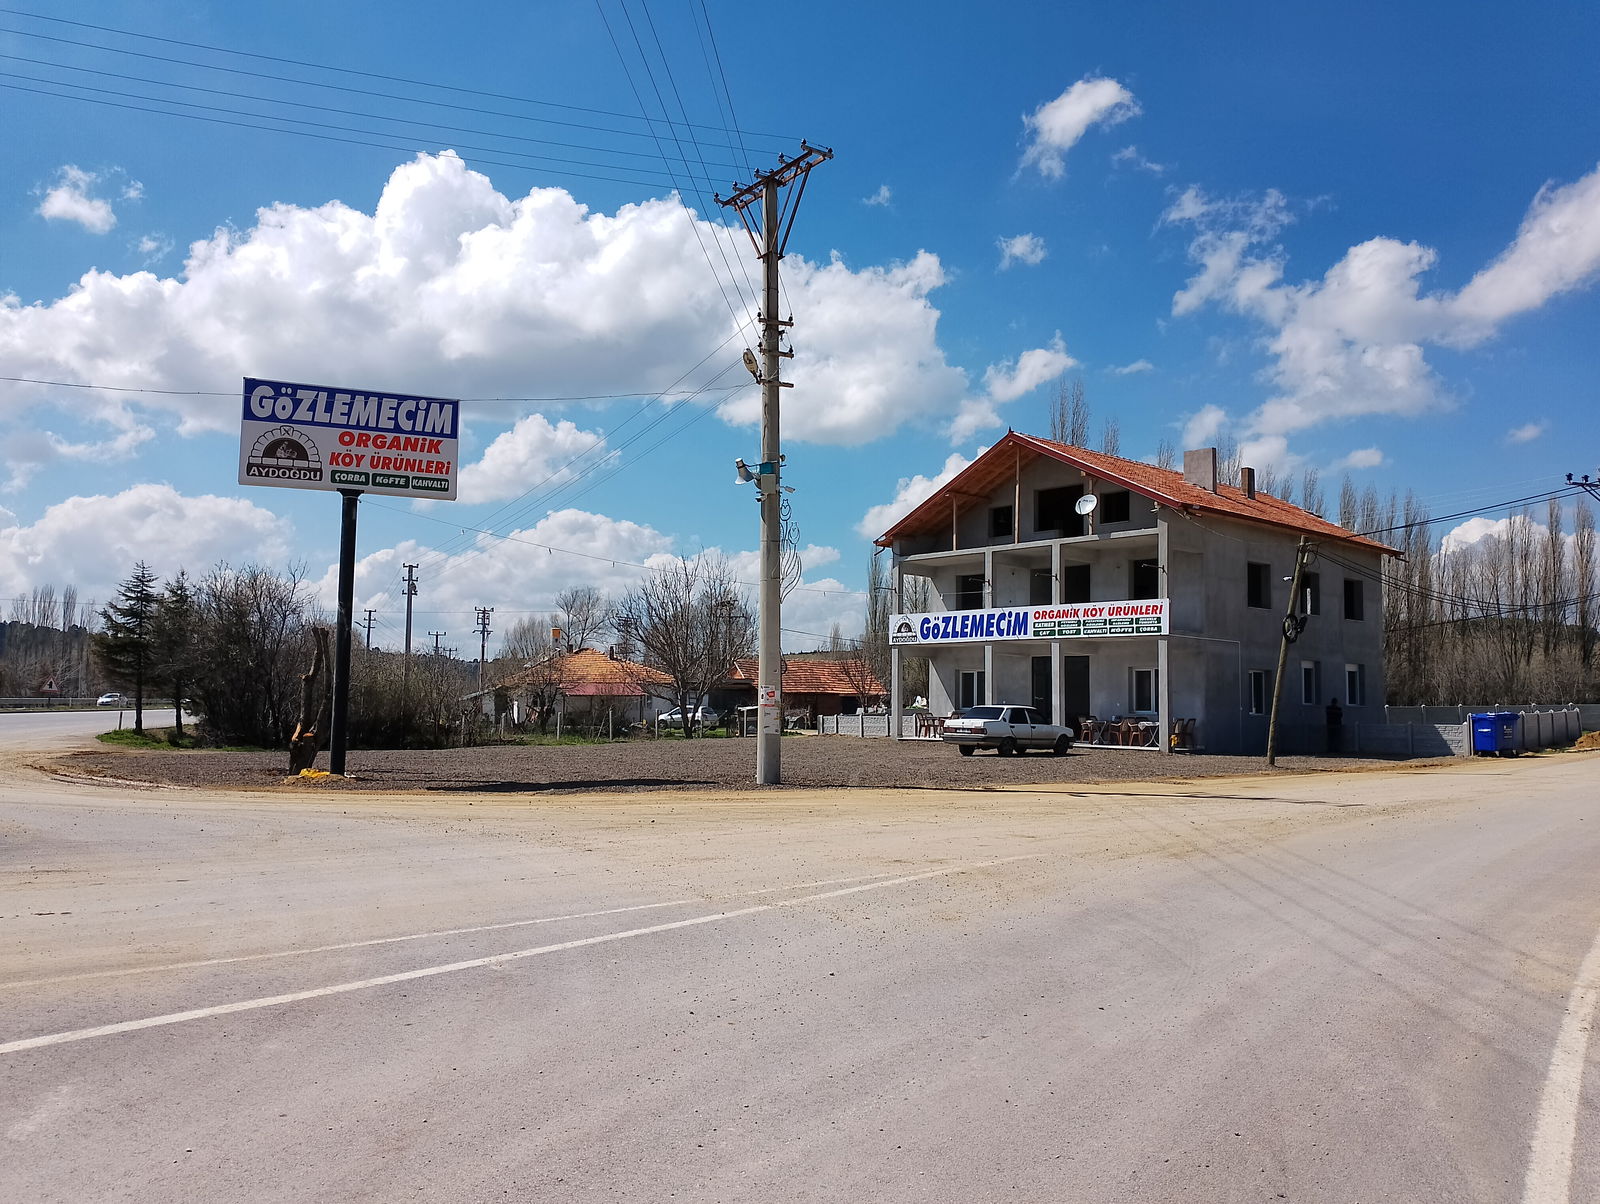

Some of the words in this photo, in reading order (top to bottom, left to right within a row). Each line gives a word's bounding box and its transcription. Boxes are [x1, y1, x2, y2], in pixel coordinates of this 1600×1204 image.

[329, 450, 366, 468] KÖY
[249, 466, 321, 481] AYDOĞDU
[334, 473, 366, 483] ÇORBA
[412, 479, 449, 489] KAHVALTI
[1083, 604, 1105, 617] KÖY
